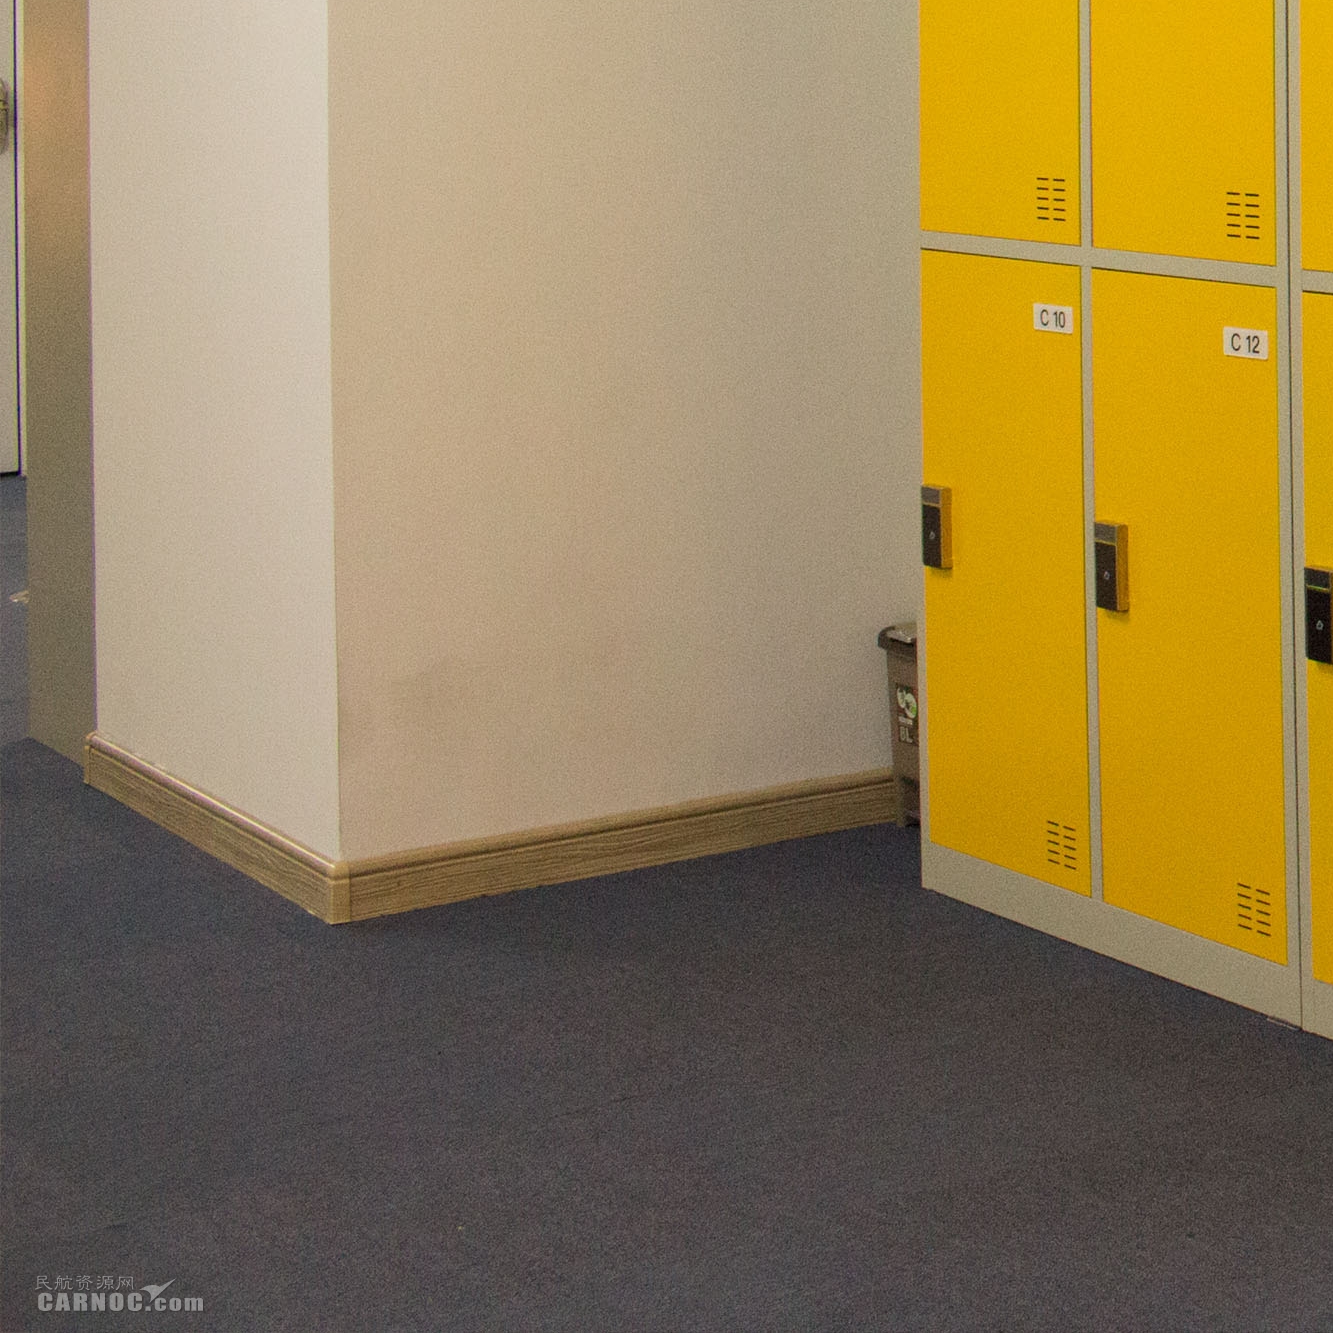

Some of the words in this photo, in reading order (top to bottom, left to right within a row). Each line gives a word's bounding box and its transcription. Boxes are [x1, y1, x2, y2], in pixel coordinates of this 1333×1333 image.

[1040, 309, 1049, 326] C
[1053, 311, 1066, 328] 10
[1231, 333, 1241, 352] C
[1246, 335, 1260, 354] 12
